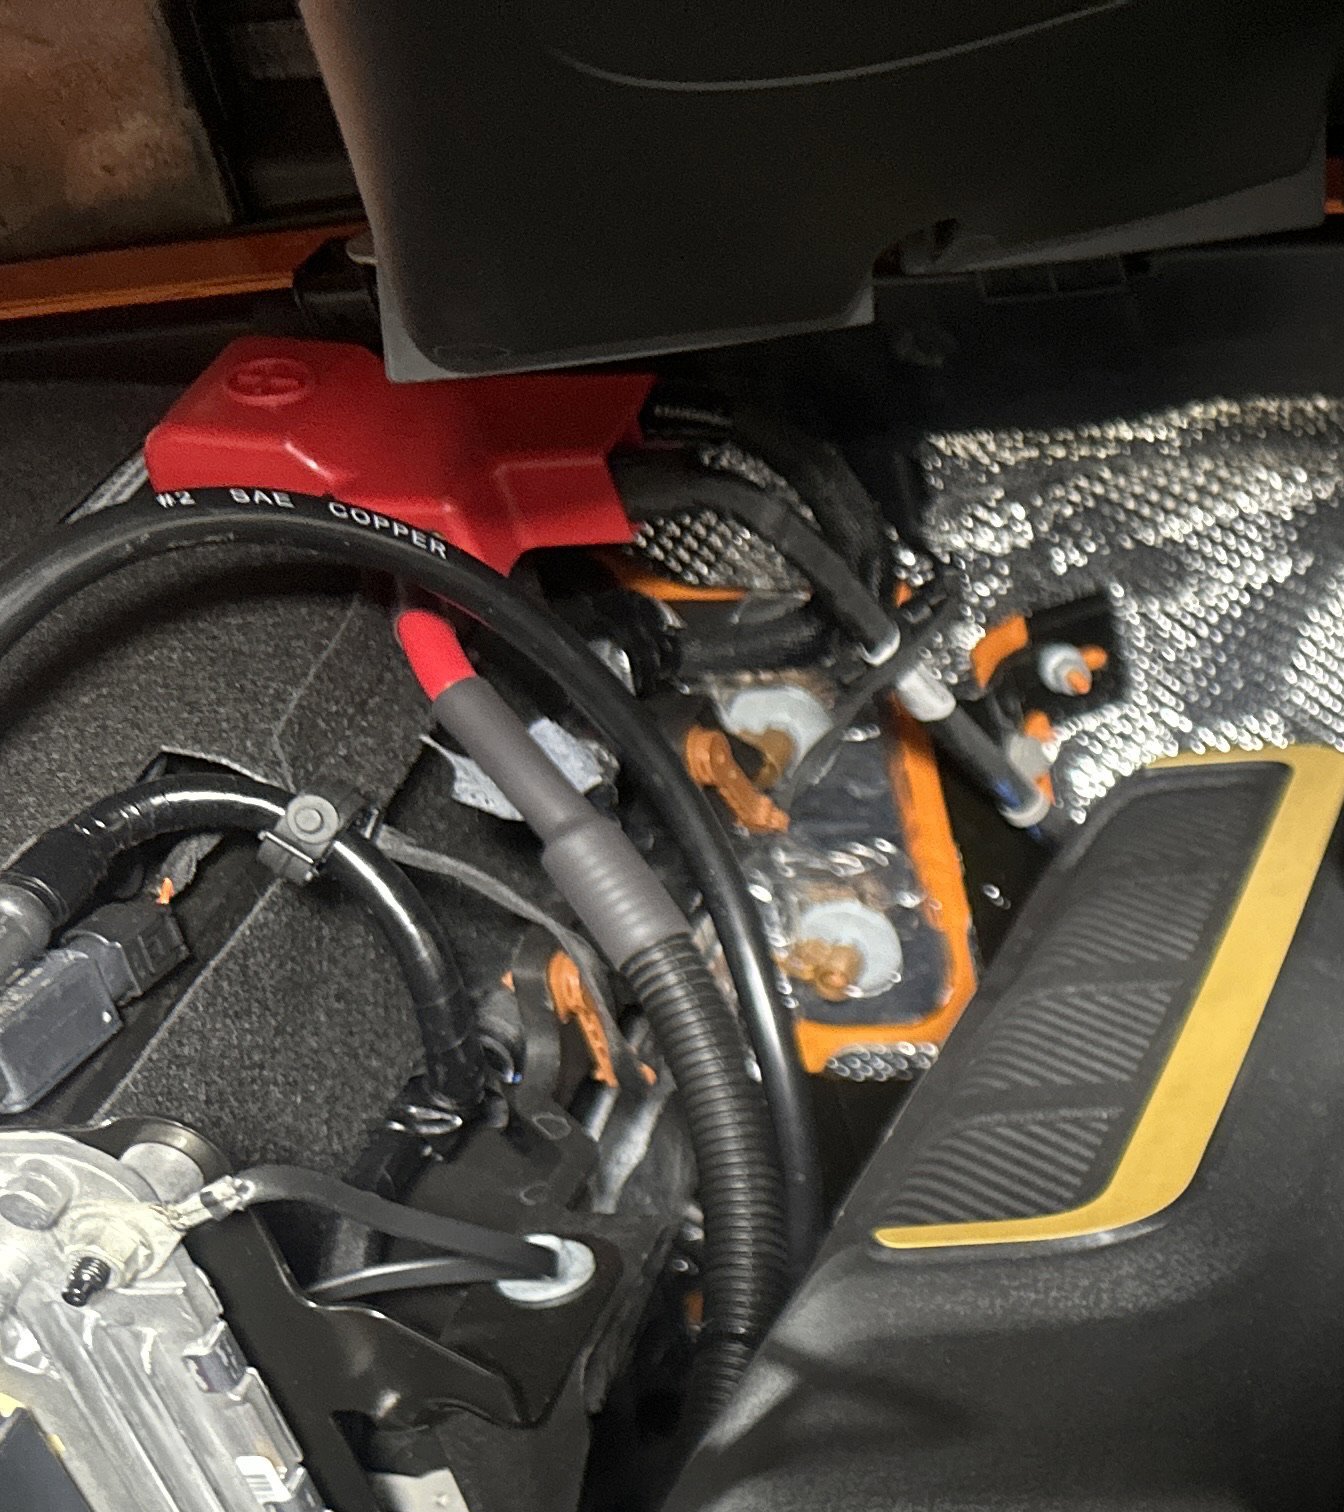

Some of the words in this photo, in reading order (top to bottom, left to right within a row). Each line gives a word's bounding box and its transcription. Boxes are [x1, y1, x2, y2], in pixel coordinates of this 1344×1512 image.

[156, 490, 196, 508] #2
[229, 487, 295, 509] SAE
[329, 501, 447, 560] COPPER
